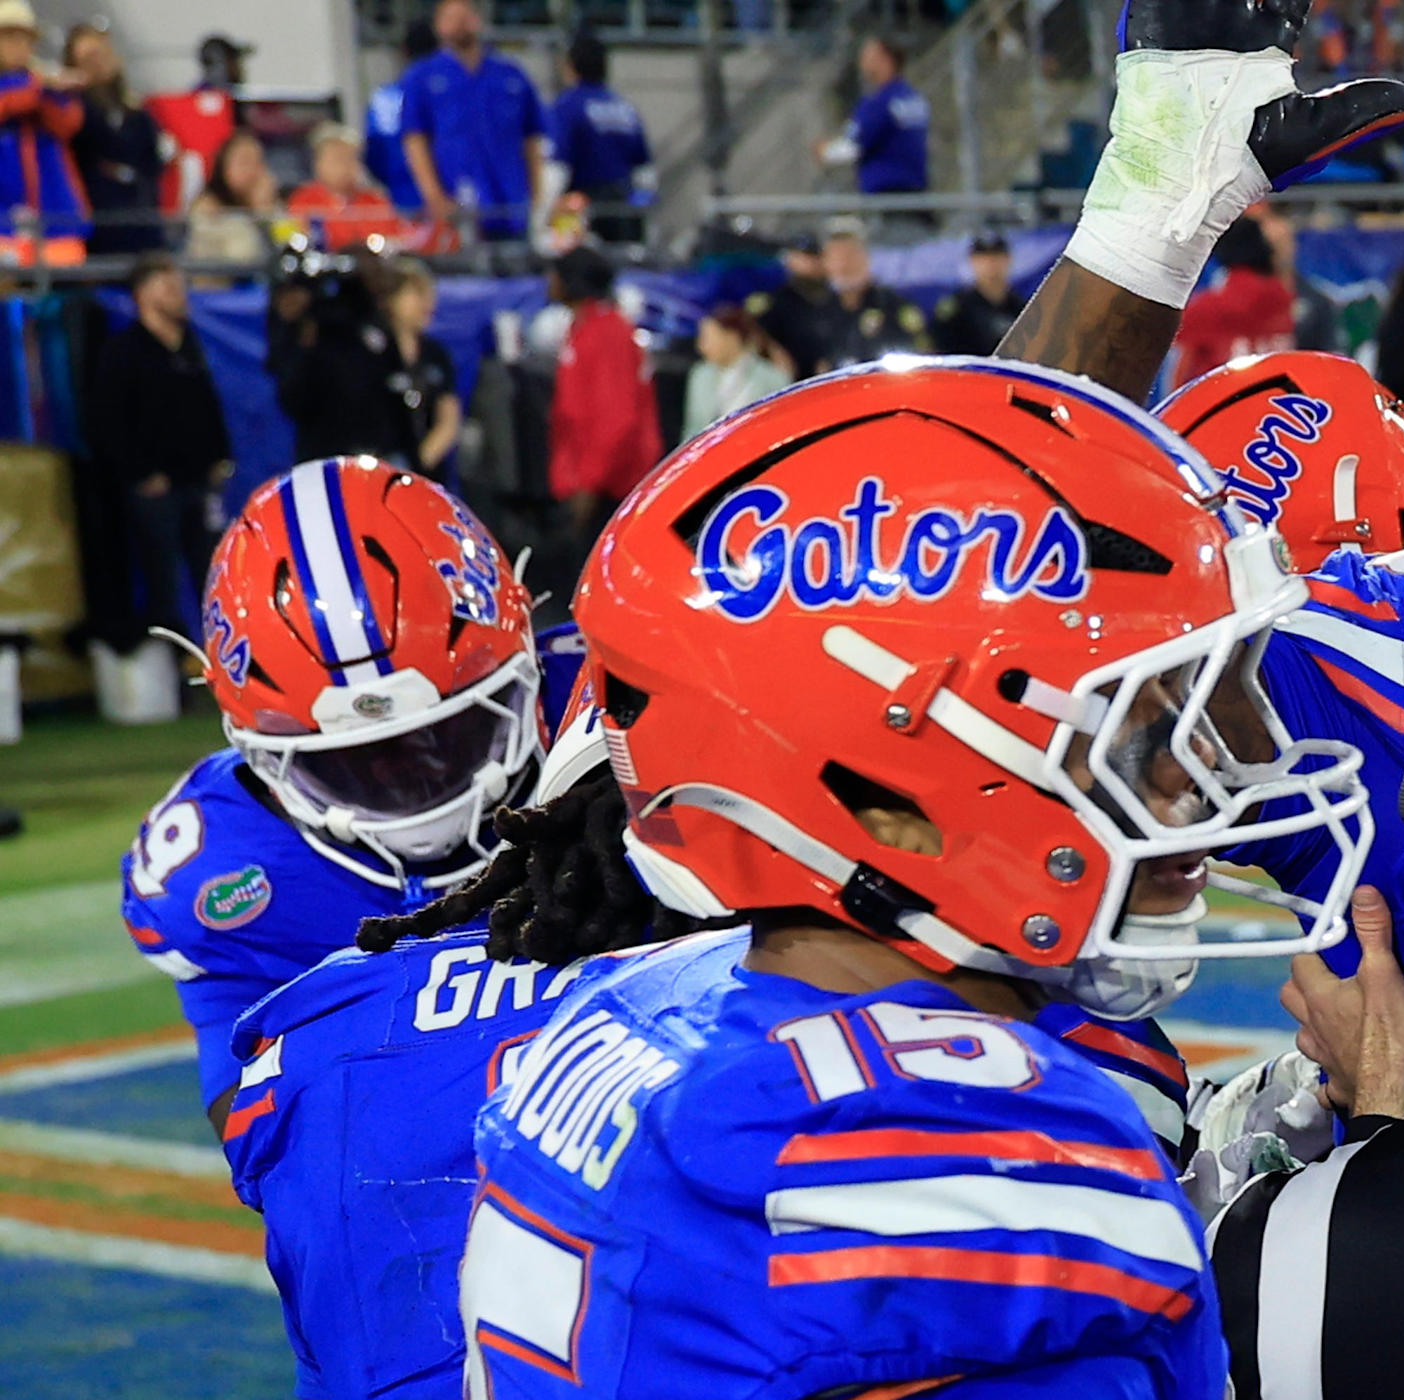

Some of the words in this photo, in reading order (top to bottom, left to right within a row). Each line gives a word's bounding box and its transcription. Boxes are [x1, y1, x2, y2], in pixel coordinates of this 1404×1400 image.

[1214, 394, 1332, 528] tors
[697, 475, 1090, 623] Gators
[500, 1008, 683, 1192] WOODS
[768, 1000, 1044, 1105] 15
